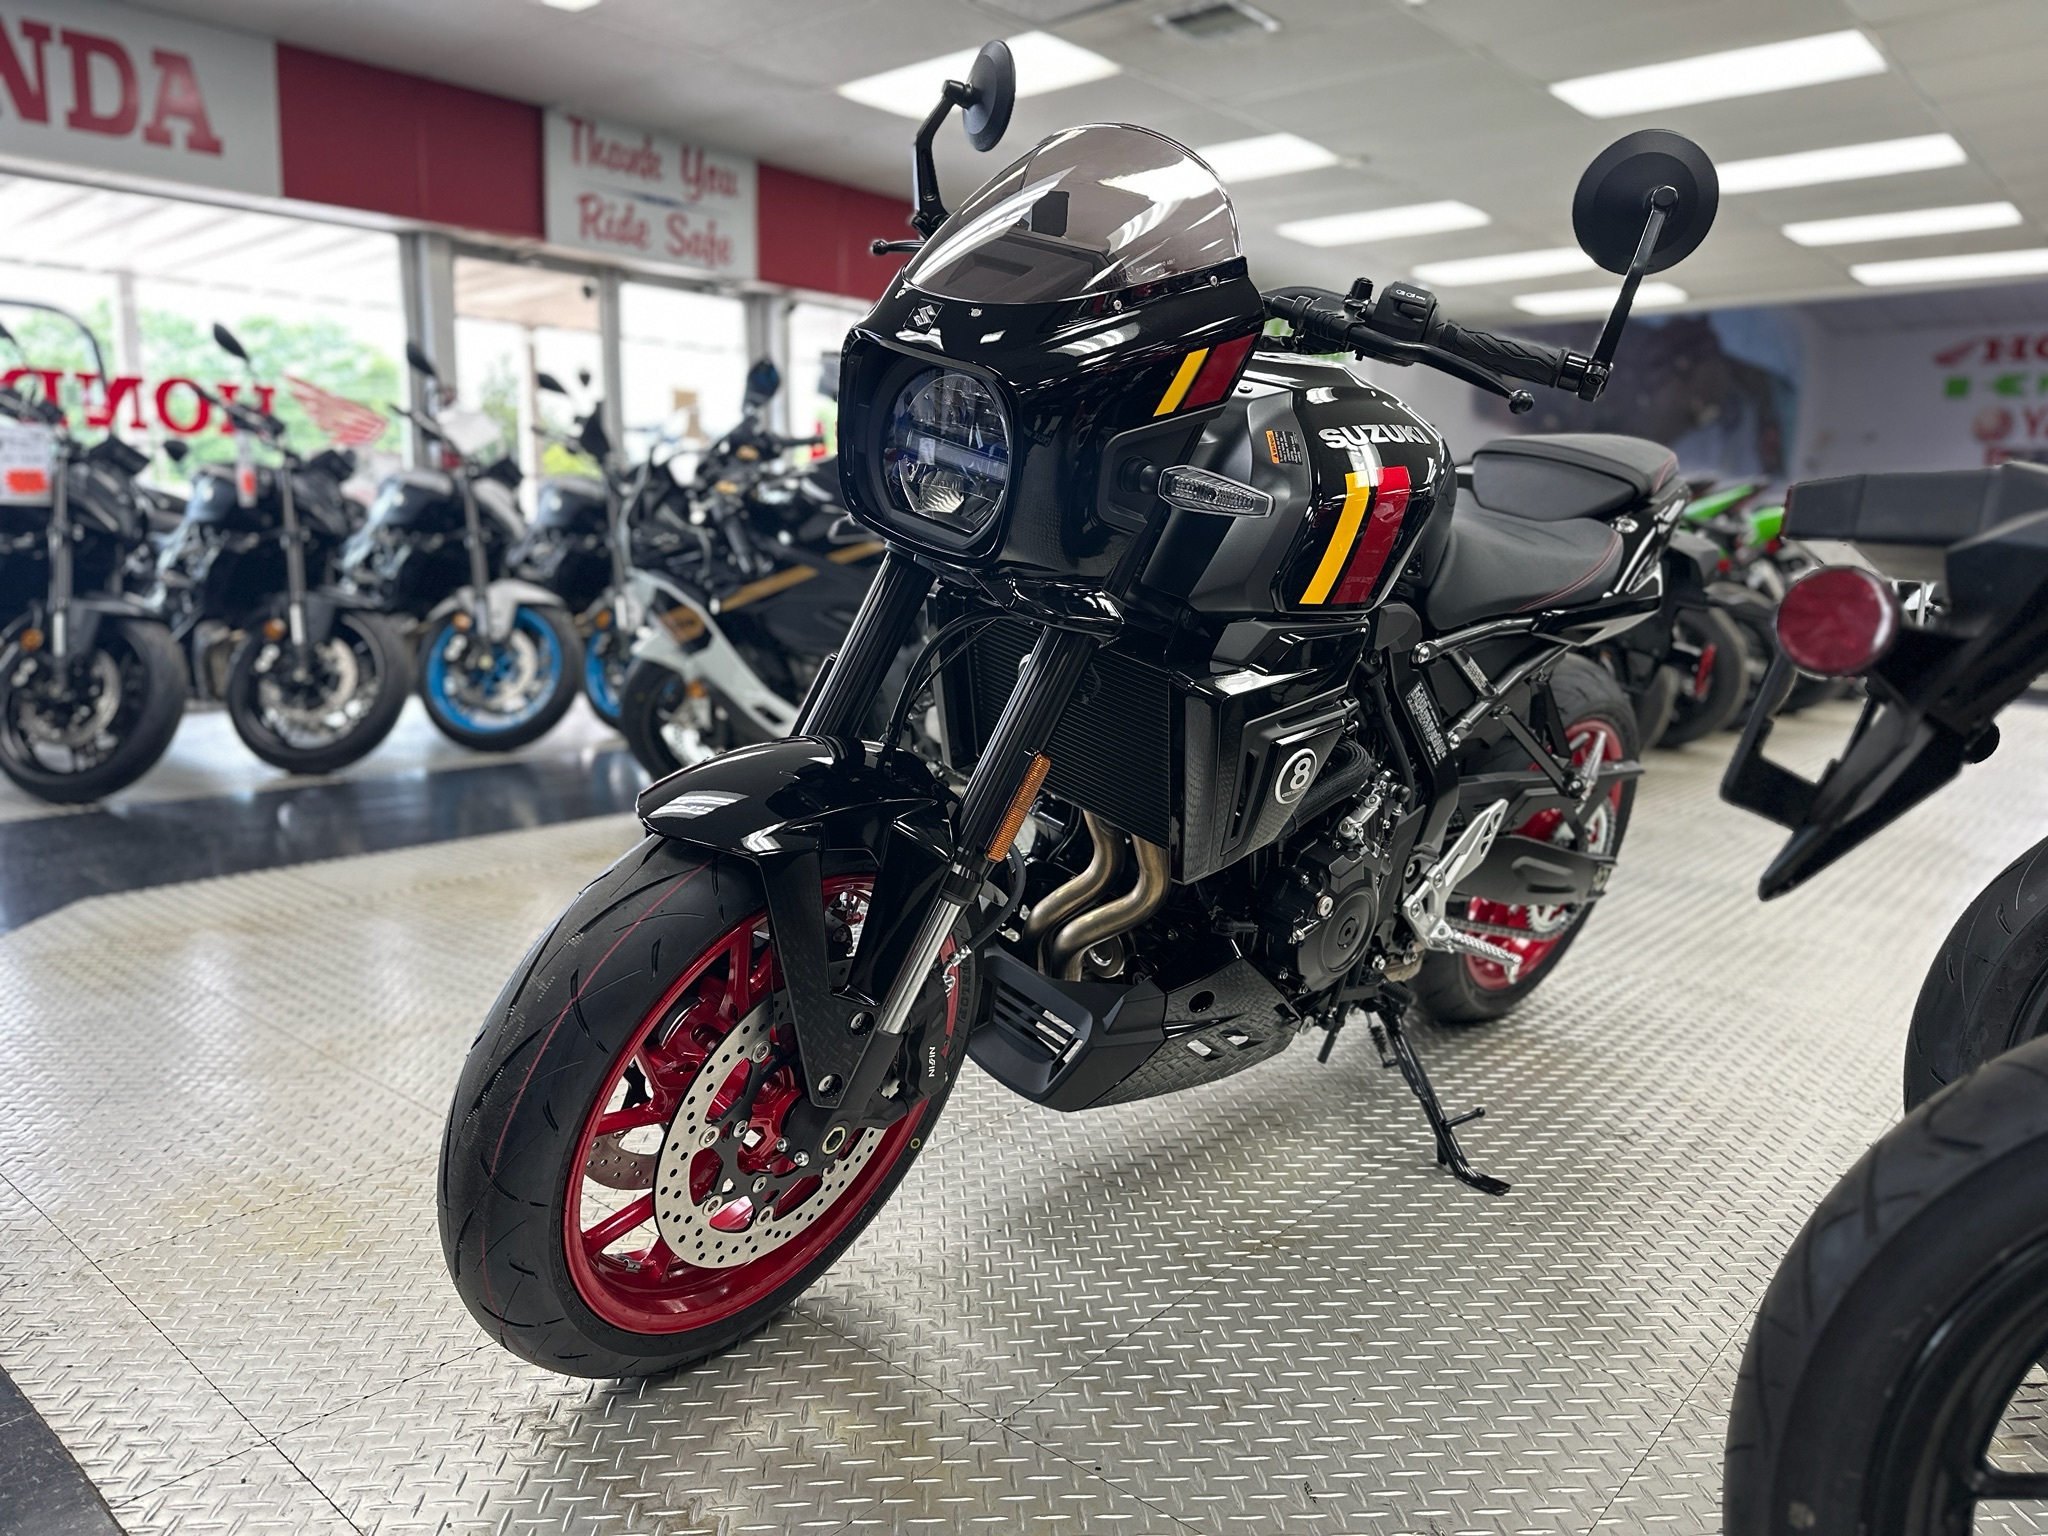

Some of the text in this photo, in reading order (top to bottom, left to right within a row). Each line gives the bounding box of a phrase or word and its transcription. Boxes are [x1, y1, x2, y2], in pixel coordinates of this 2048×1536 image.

[566, 114, 739, 204] Thank You
[576, 192, 733, 270] Ride Safe
[1318, 424, 1431, 449] SUZUKI
[1289, 757, 1312, 790] 8
